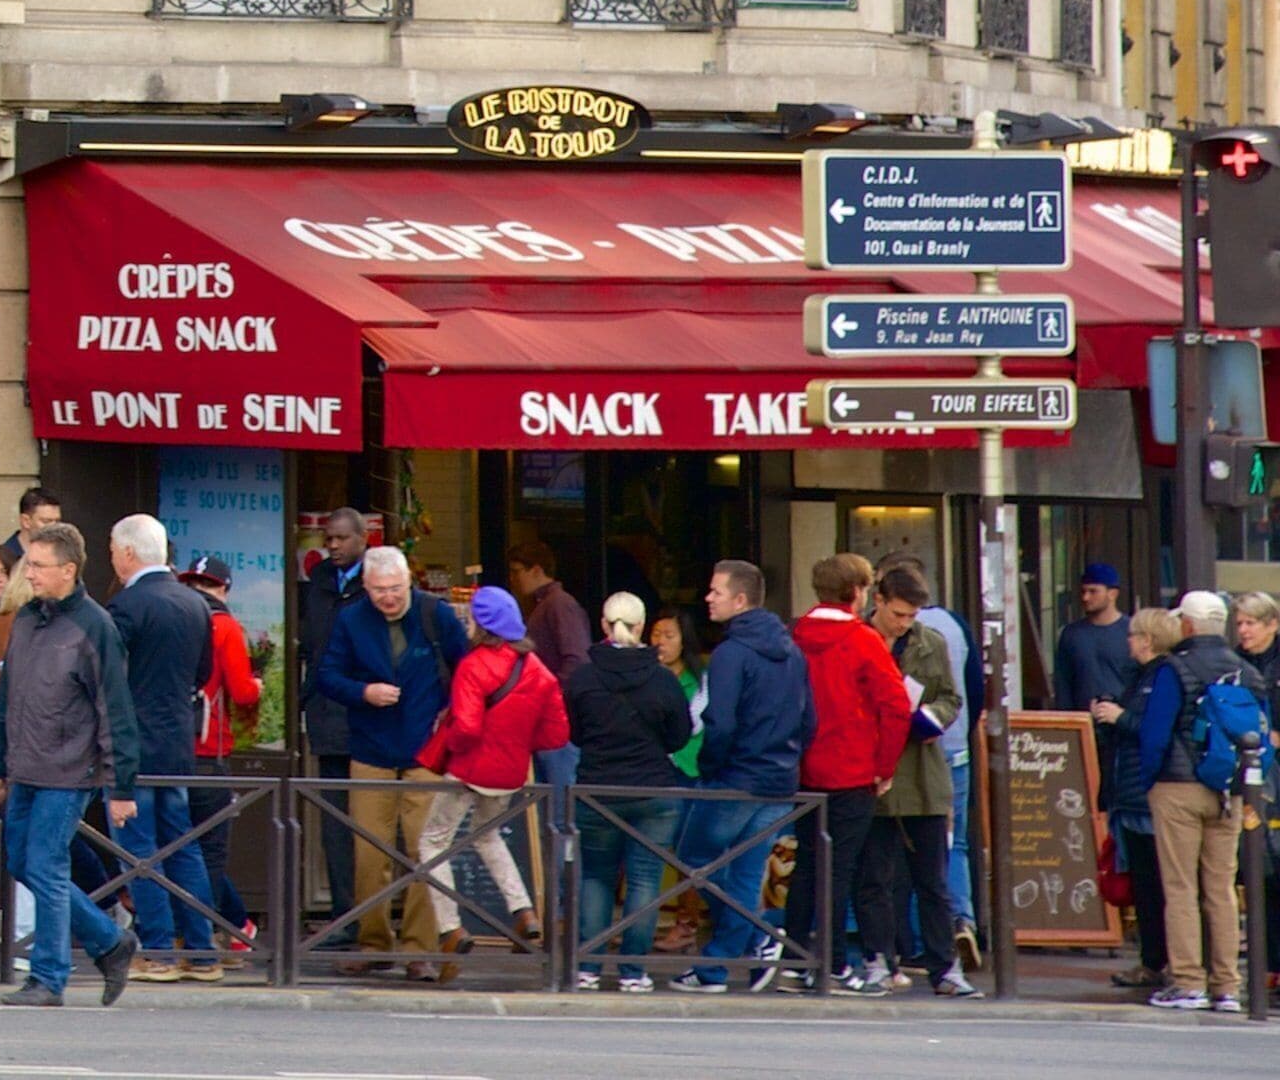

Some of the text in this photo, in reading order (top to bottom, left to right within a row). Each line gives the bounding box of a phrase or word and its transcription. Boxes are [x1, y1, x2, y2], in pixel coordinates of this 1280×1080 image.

[463, 88, 635, 127] LE BISTROT
[484, 126, 619, 159] LA TOUR
[863, 166, 919, 186] C.I.D.J.
[863, 192, 1025, 210] Centre d'Information et de
[864, 216, 1026, 233] Documentation de la Jeunesse
[283, 214, 586, 264] CRÊPES
[864, 239, 970, 258] 101, Quai Branly
[118, 254, 234, 300] CRÊPES
[877, 306, 1034, 326] Piscine E. ANTHOINE
[77, 316, 278, 352] PIZZA SNACK
[895, 330, 919, 346] Rue
[925, 330, 954, 346] Jean
[961, 330, 983, 347] Rey
[52, 392, 342, 436] LE PONT DE SEINE
[519, 392, 813, 437] SNACK TAKE
[931, 393, 1036, 413] TOUR EIFFEL
